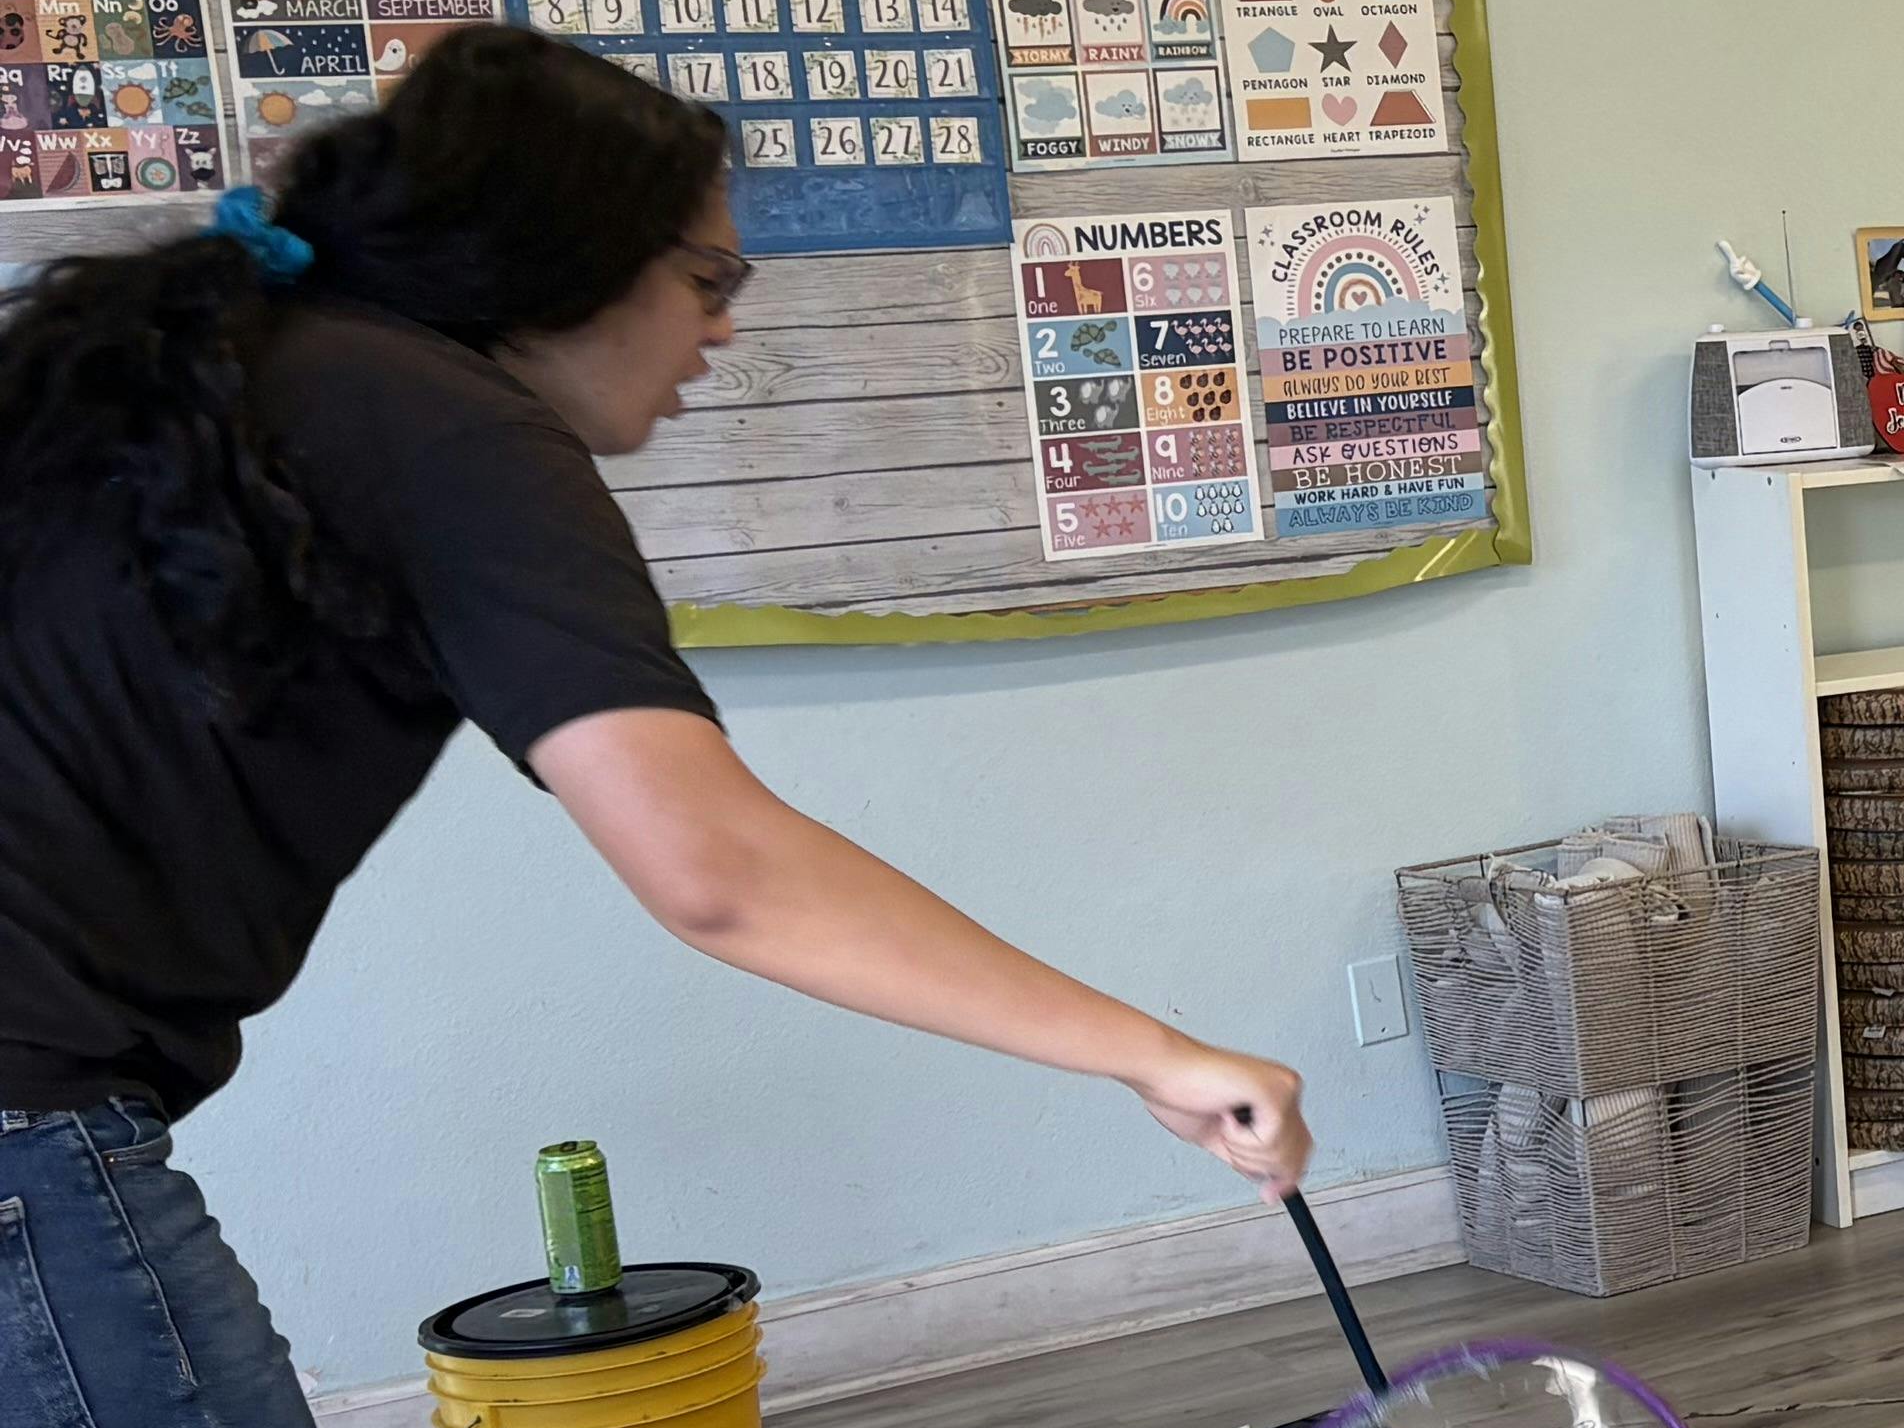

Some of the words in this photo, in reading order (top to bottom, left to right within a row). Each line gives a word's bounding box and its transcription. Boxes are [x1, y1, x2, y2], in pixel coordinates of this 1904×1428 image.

[287, 0, 359, 17] MARCH
[1236, 6, 1298, 17] TRIANGLE
[1313, 6, 1344, 17] OVAL
[1361, 4, 1417, 15] OCTAGON
[301, 55, 366, 74] APRIL
[1089, 48, 1140, 61] RAINY
[686, 62, 713, 93] 17
[752, 60, 779, 92] 18
[820, 60, 845, 92] 19
[874, 59, 909, 90] 20
[938, 57, 966, 88] 21
[1243, 78, 1308, 91] PENTAGON
[1322, 76, 1351, 87] STAR
[1367, 73, 1426, 85] DIAMOND
[753, 128, 786, 158] 25
[820, 126, 856, 156] 26
[880, 125, 911, 155] 27
[938, 124, 972, 154] 28
[1247, 134, 1315, 147] RECTANGLE
[1324, 131, 1361, 143] HEART
[1369, 128, 1436, 140] TRAPEZOID
[1027, 142, 1079, 156] FOGGY
[1099, 138, 1150, 152] WINDY
[1075, 220, 1223, 251] NUMBERS
[1272, 210, 1382, 283] CLASSROOM
[1391, 219, 1440, 276] RULES
[1035, 267, 1045, 297] 1
[1133, 262, 1152, 291] 6
[1028, 299, 1058, 314] One
[1135, 292, 1157, 308] Six
[1150, 321, 1169, 350] 7
[1279, 324, 1353, 346] PREPARE
[1361, 322, 1382, 339] TO
[1388, 318, 1445, 337] LEARN
[1036, 329, 1058, 358] 2
[1140, 351, 1186, 365] Seven
[1282, 350, 1312, 371] BE
[1324, 340, 1447, 368] POSITIVE
[1034, 359, 1065, 374] Two
[1345, 374, 1365, 390] DO
[1416, 368, 1450, 385] BEST
[1051, 386, 1071, 416] 3
[1154, 376, 1173, 406] 8
[1147, 406, 1185, 423] Eight
[1287, 400, 1348, 420] BELIEVE
[1354, 397, 1371, 414] IN
[1379, 390, 1453, 410] YOURSELF
[1040, 416, 1086, 432] Three
[1291, 425, 1317, 442] BE
[1327, 412, 1455, 438] RESPECTFUL
[1050, 444, 1072, 473] 4
[1155, 434, 1175, 463] 9
[1293, 446, 1331, 464] ASK
[1341, 433, 1458, 460] QUESTIONS
[1152, 464, 1185, 478] Nine
[1293, 467, 1331, 489] BE
[1344, 455, 1462, 484] HONEST
[1046, 474, 1081, 490] Four
[1295, 490, 1335, 504] WORK
[1341, 484, 1378, 500] HARD
[1400, 480, 1432, 494] HAVE
[1438, 477, 1464, 489] FUN
[1155, 493, 1187, 522] 10
[1289, 505, 1379, 527] ALWAYS
[1385, 501, 1412, 518] BE
[1418, 493, 1473, 514] KIND
[1057, 503, 1078, 533] 5
[1053, 532, 1086, 548] Five
